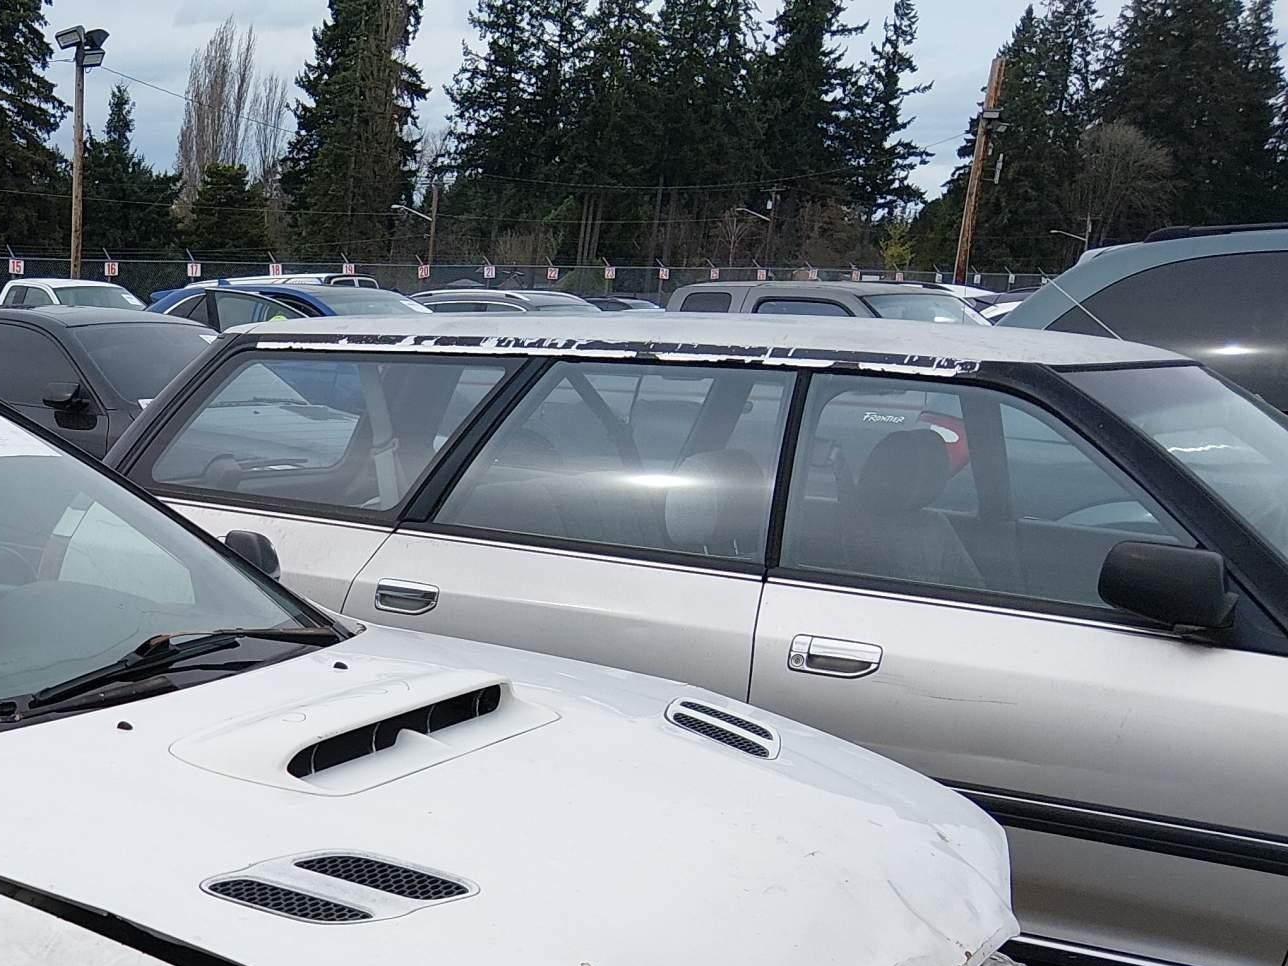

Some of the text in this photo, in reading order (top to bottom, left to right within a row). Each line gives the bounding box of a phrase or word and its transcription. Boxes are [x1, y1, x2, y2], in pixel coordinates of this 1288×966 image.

[11, 260, 22, 274] 15
[107, 263, 117, 275] 16
[190, 265, 199, 275] 17
[271, 264, 280, 275] 18
[419, 265, 430, 278] 20
[549, 268, 559, 279] 22
